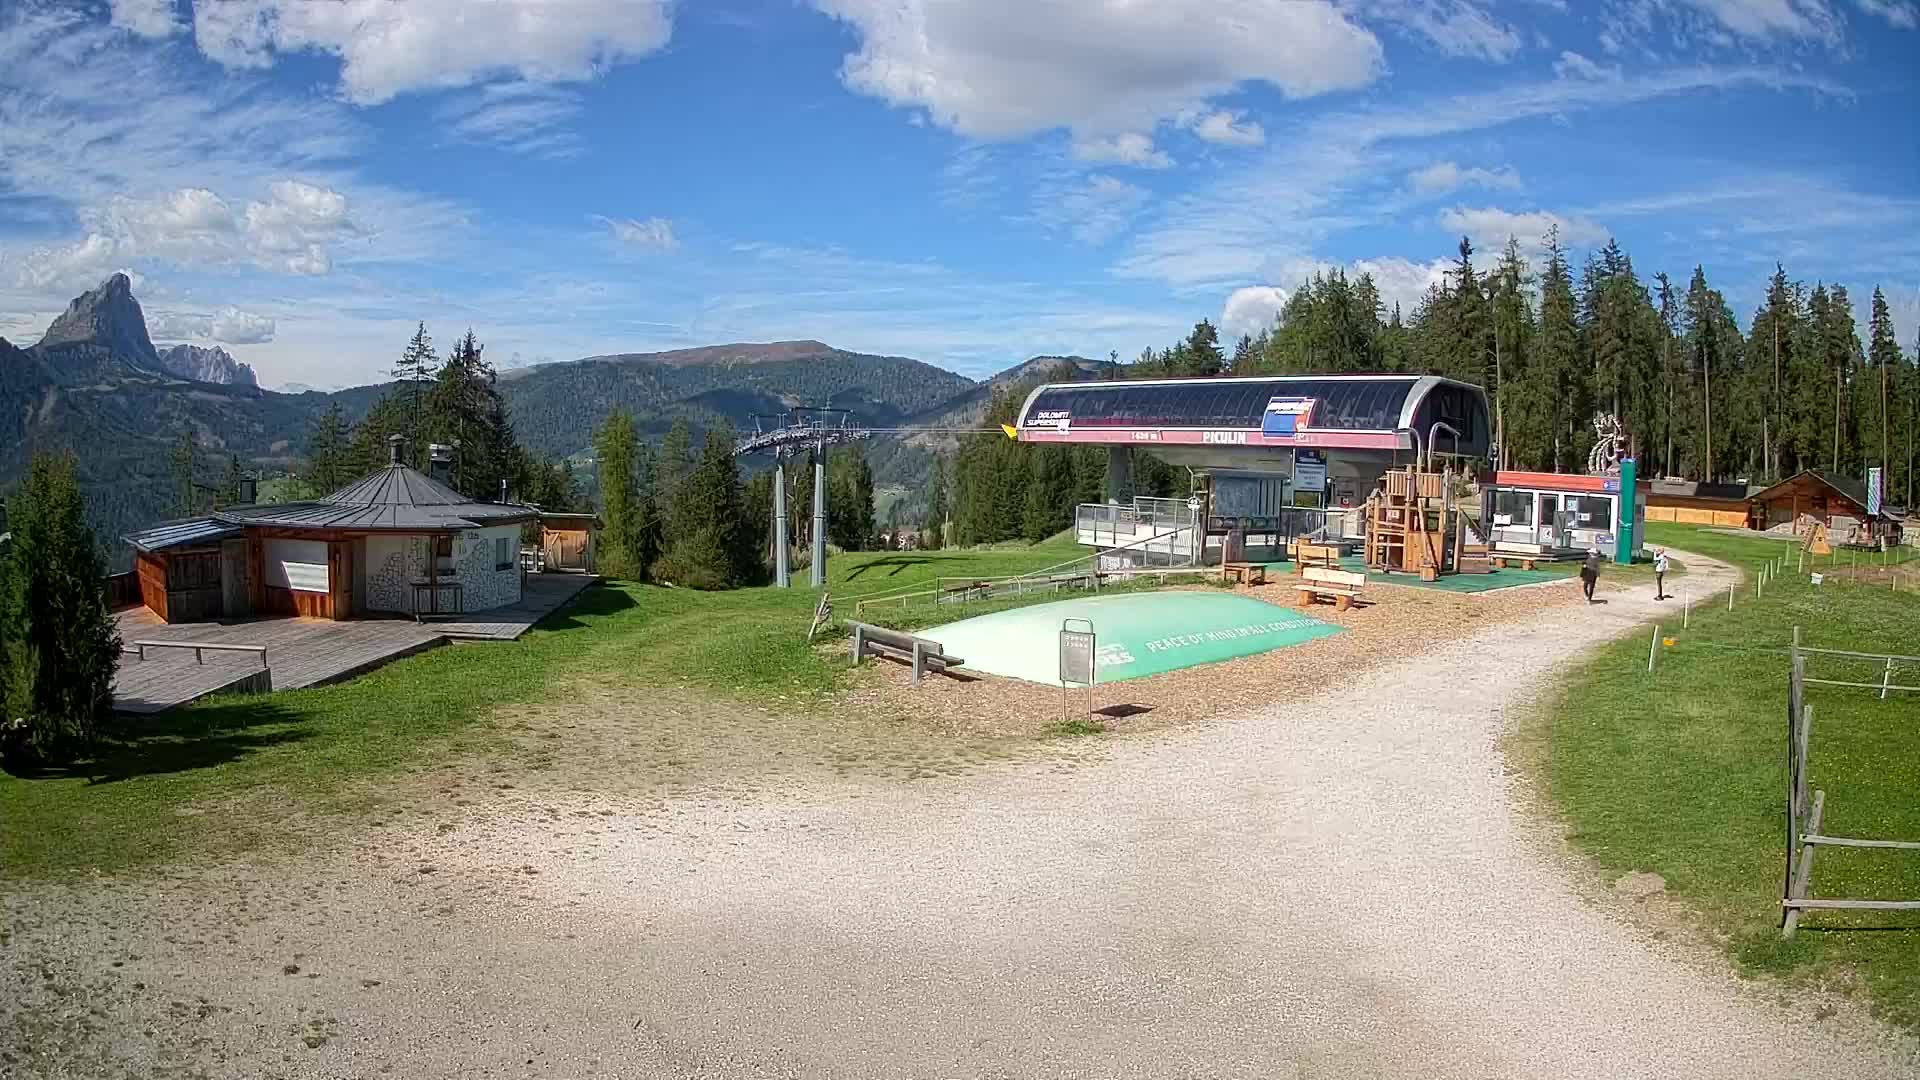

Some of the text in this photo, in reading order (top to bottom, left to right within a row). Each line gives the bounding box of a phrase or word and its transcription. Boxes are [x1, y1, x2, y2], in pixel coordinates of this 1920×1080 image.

[1202, 431, 1246, 444] PICULIN
[1145, 636, 1189, 653] PEACE
[1189, 633, 1205, 644] OF
